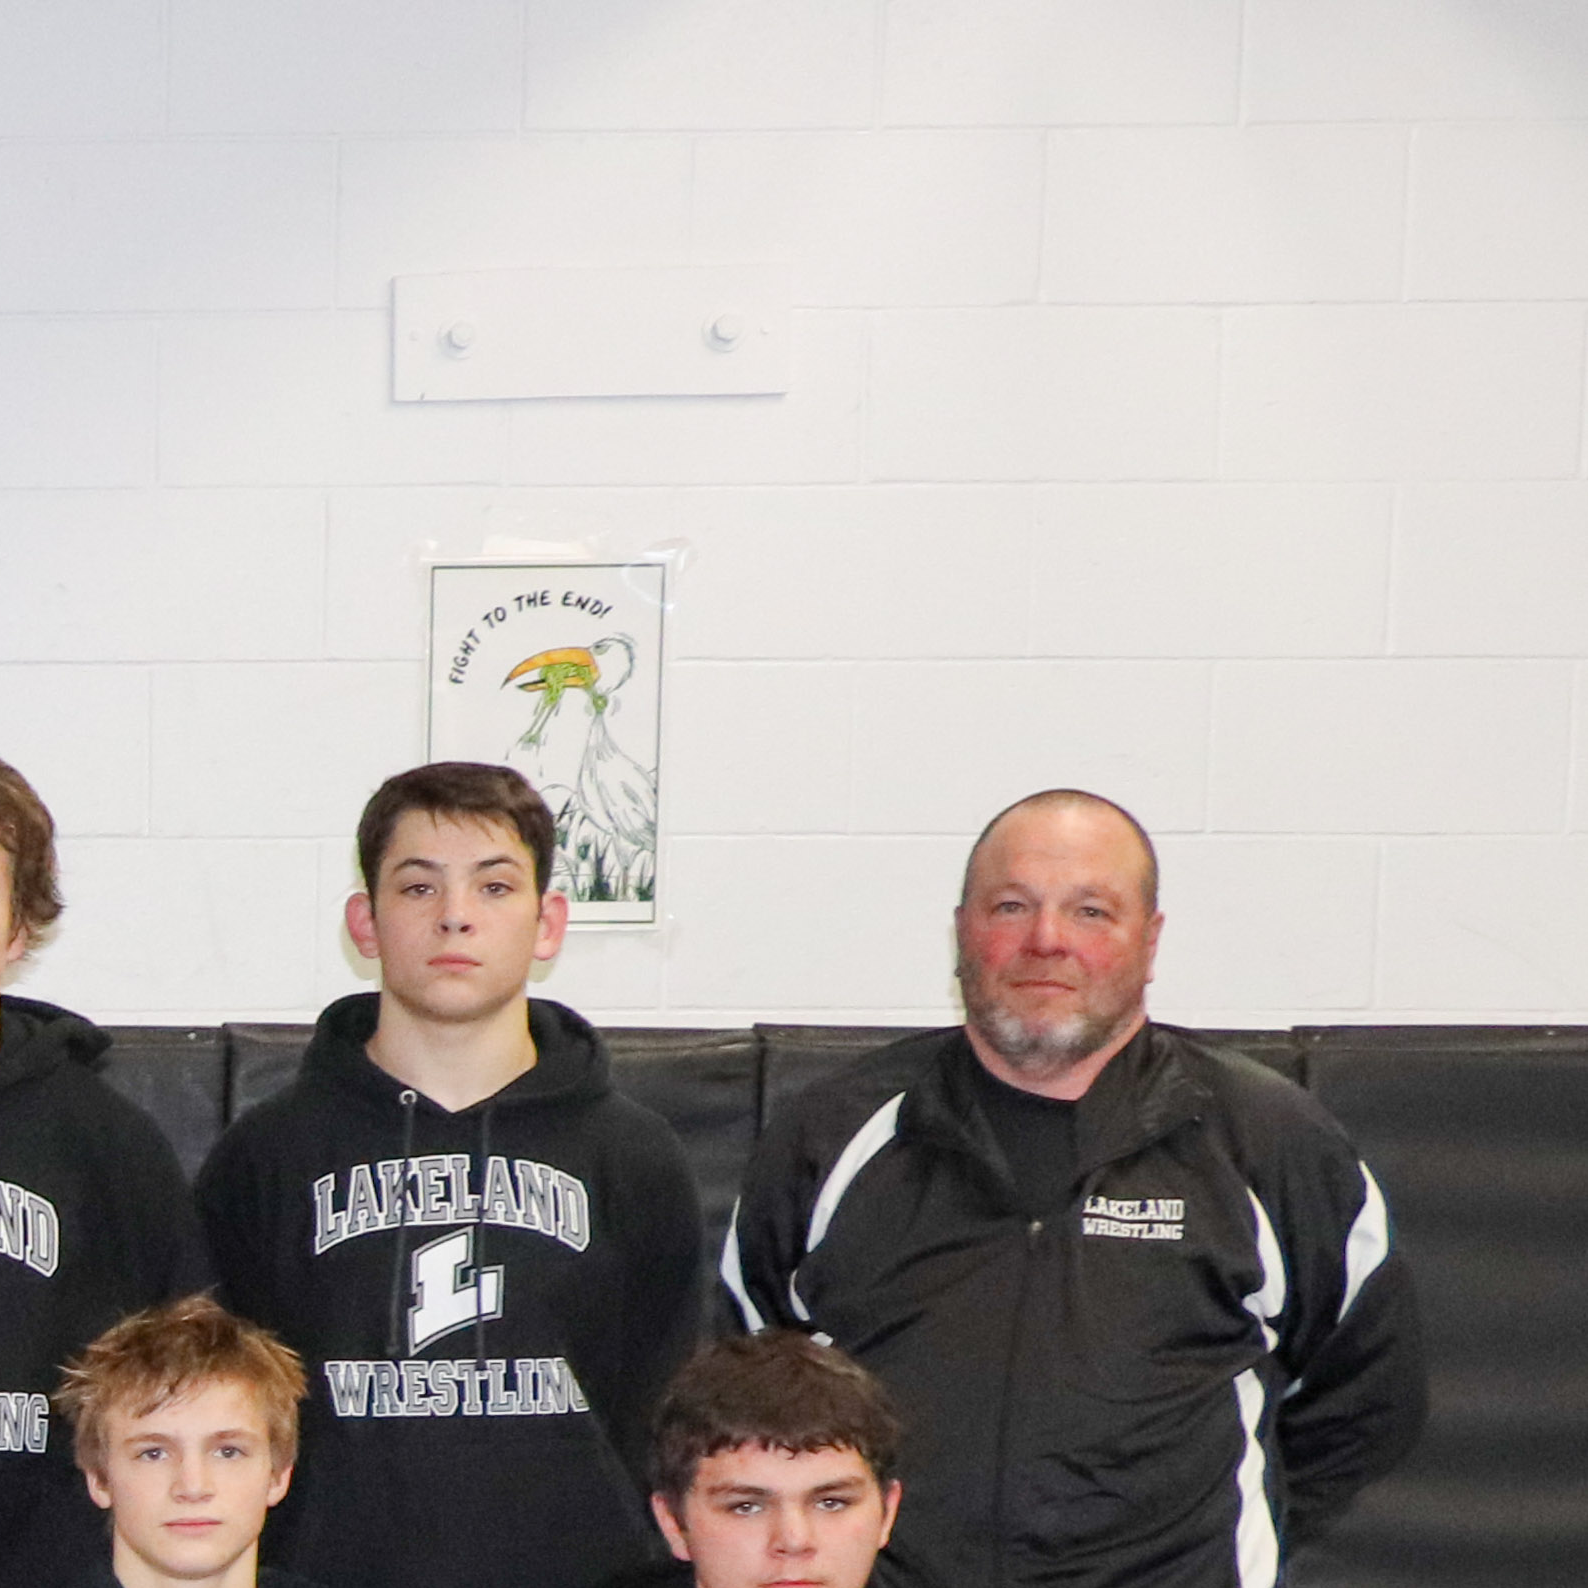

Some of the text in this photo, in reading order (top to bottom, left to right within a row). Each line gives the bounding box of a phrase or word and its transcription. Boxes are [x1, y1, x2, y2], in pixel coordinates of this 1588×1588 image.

[449, 590, 613, 684] FIGHT TO THE END!
[314, 1153, 591, 1255] LAKELAND
[1083, 1196, 1185, 1221] LAKELAND
[1083, 1217, 1184, 1240] WRESTLING
